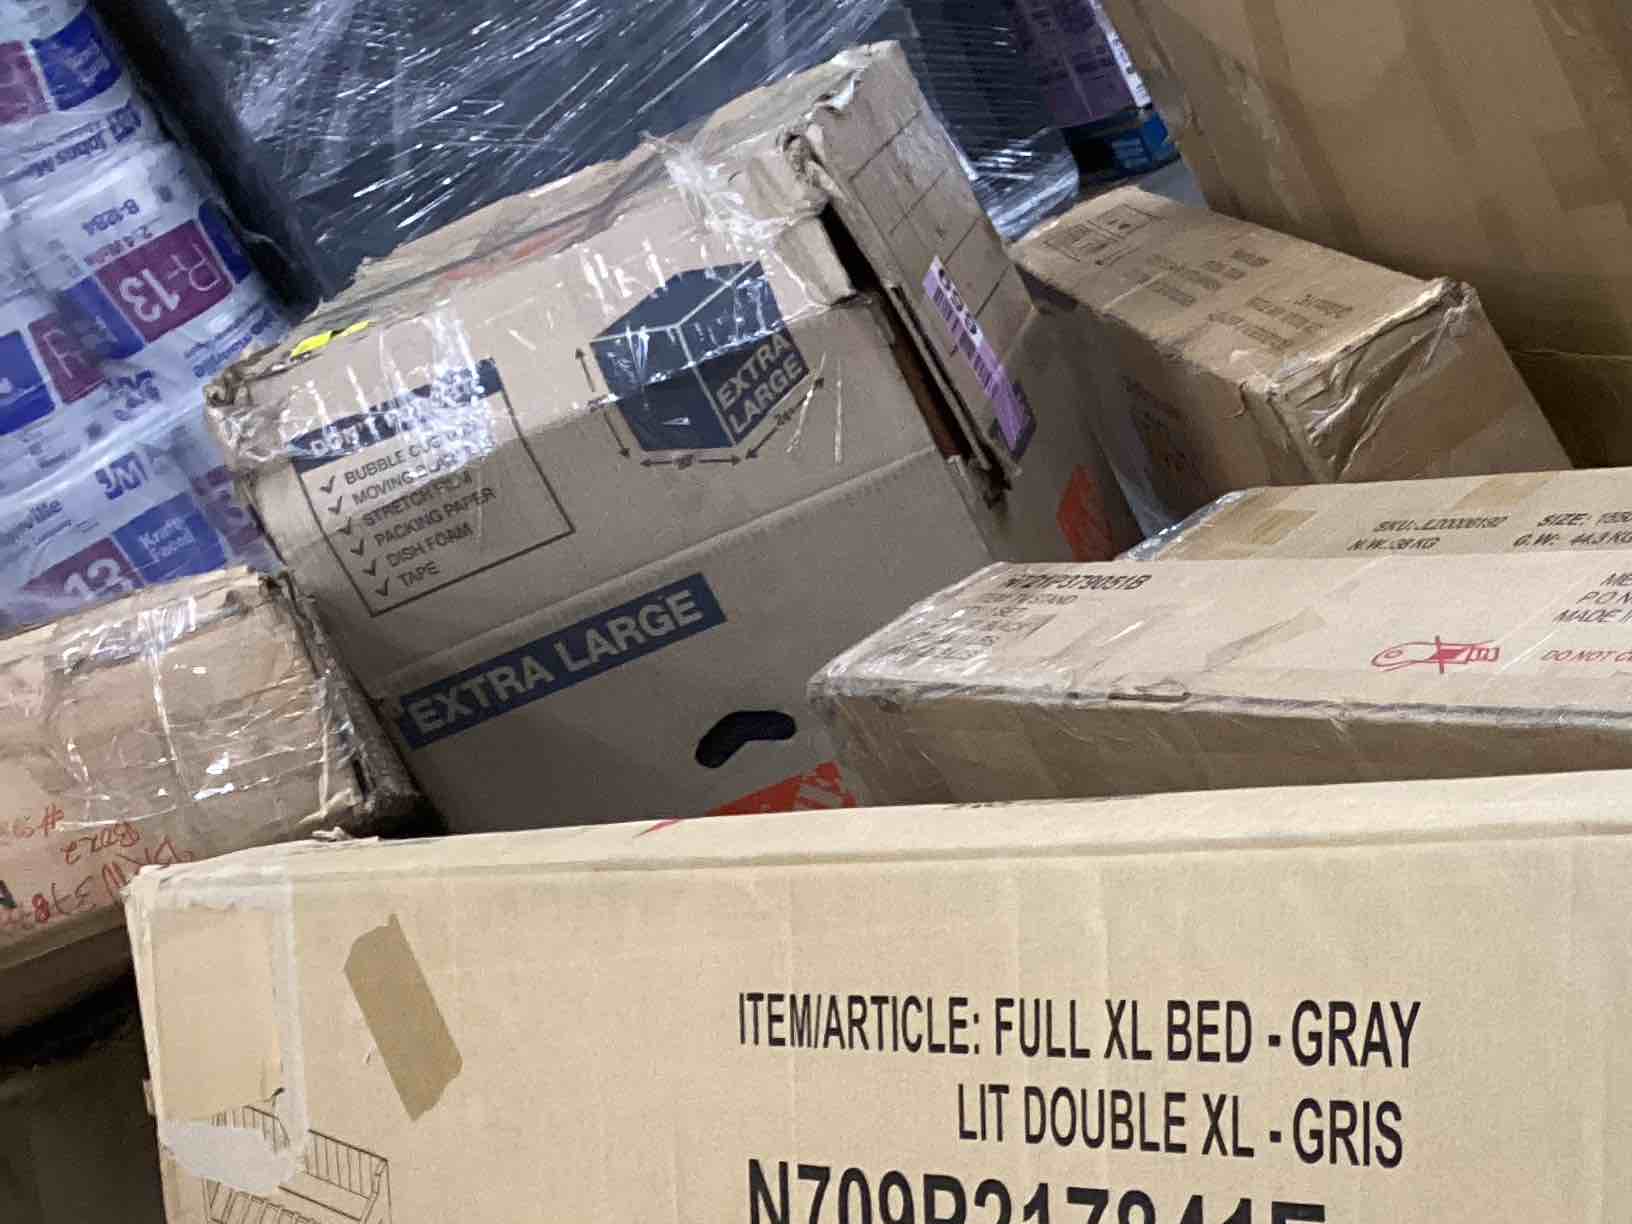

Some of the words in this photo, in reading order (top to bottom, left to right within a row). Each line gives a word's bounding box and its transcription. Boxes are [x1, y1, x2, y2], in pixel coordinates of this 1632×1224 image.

[717, 331, 792, 410] EXTRA
[729, 354, 803, 434] LARGE
[397, 560, 440, 587] TAPE
[1554, 608, 1618, 624] MADE
[408, 654, 555, 736] EXTRA
[553, 588, 704, 673] LARGE
[739, 992, 980, 1055] ITEM/ARTICLE:
[995, 997, 1091, 1059] FULL
[1104, 999, 1153, 1061] XL
[1167, 1000, 1252, 1063] BED
[1292, 1000, 1421, 1069] GRAY
[958, 1083, 1010, 1142] LIT
[1024, 1086, 1187, 1154] DOUBLE
[1201, 1093, 1255, 1158] XL
[1293, 1097, 1402, 1169] GRIS
